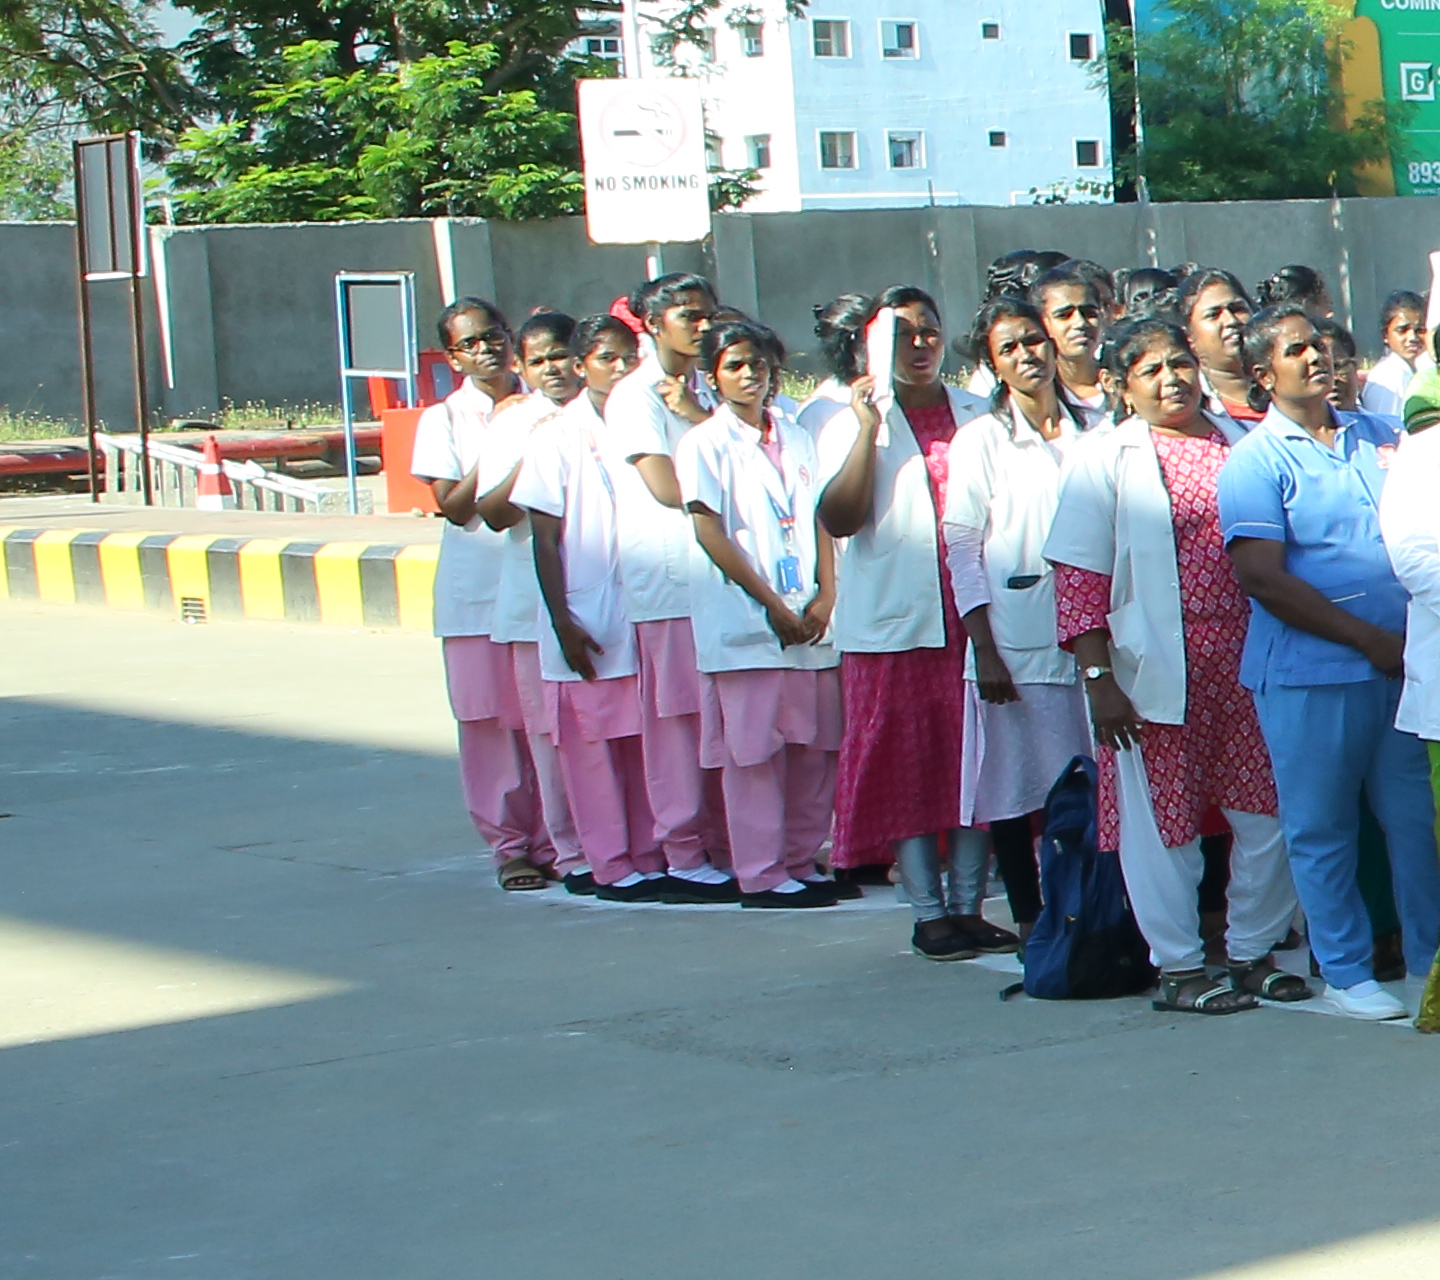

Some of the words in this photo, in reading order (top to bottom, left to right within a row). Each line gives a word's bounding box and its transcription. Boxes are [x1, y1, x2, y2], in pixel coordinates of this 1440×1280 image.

[1410, 72, 1425, 91] G
[594, 176, 617, 192] NO
[622, 173, 700, 192] SMOKING
